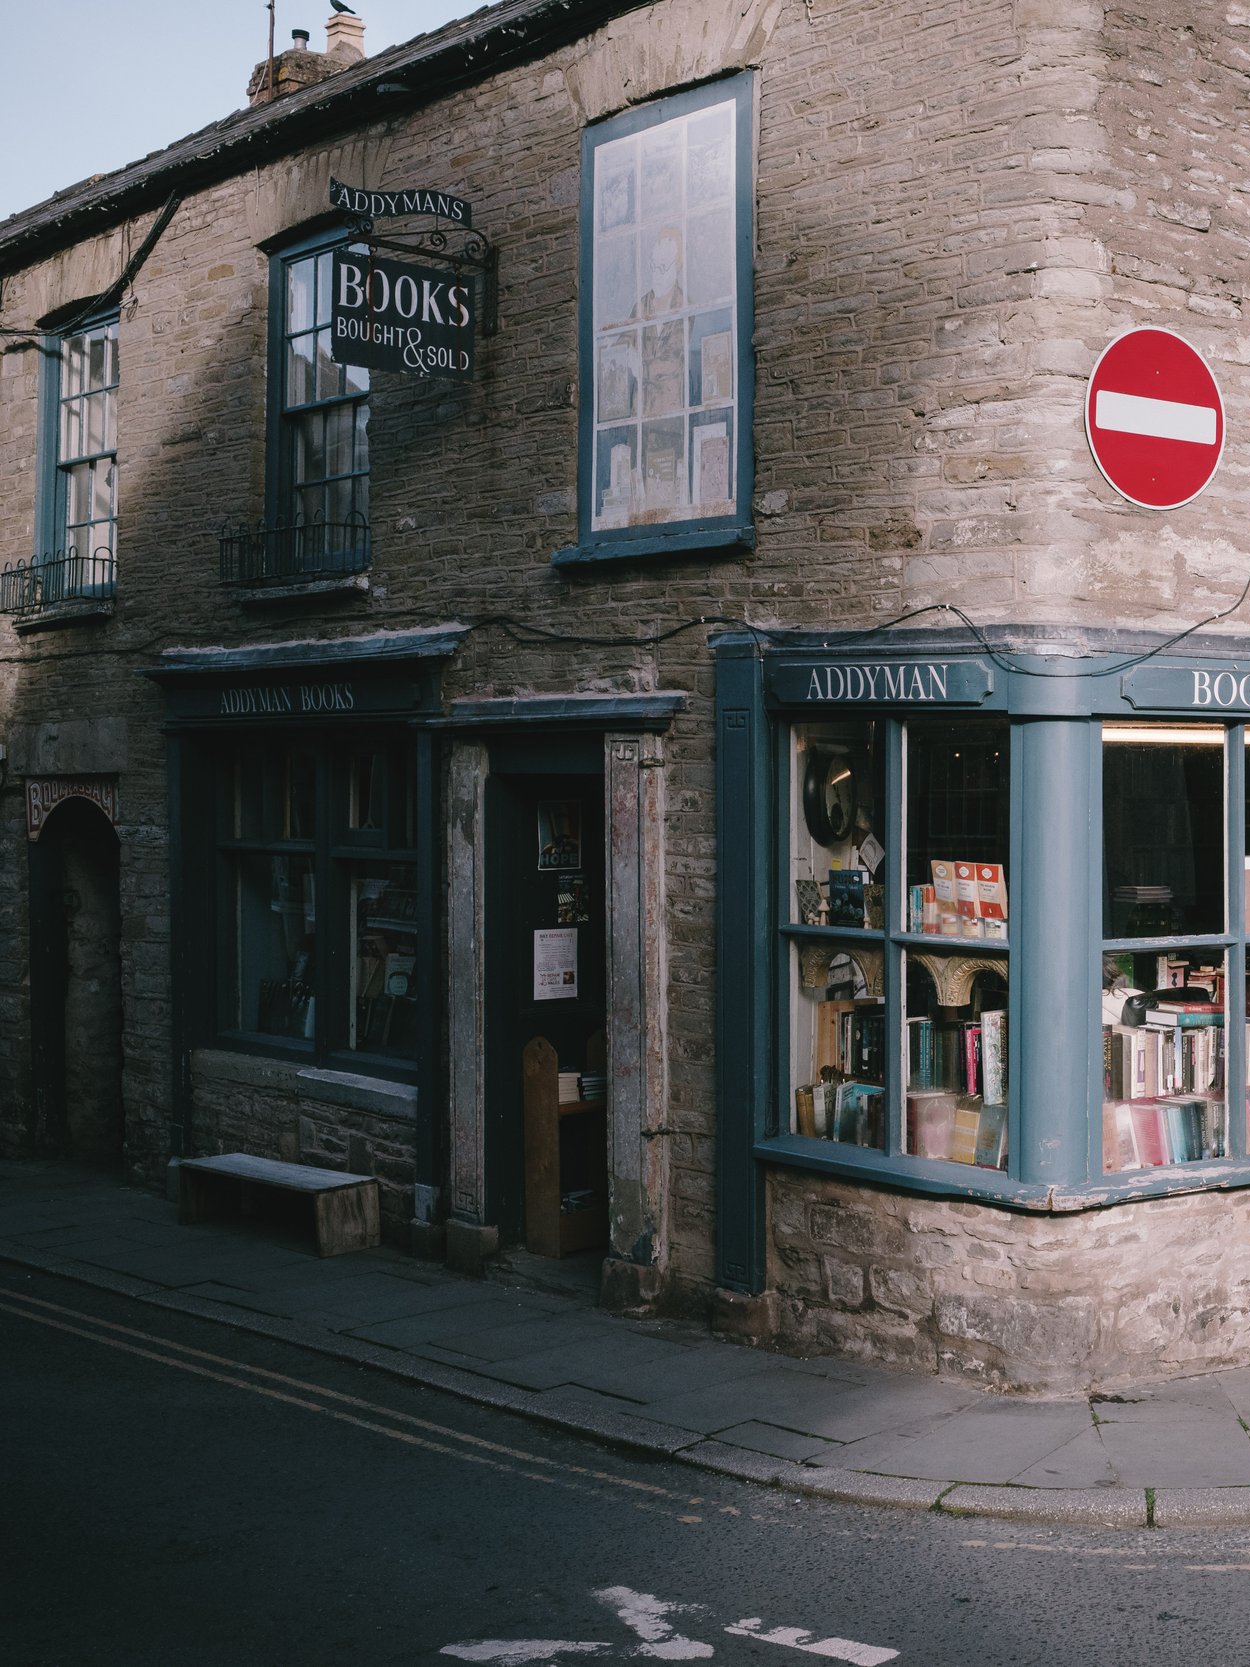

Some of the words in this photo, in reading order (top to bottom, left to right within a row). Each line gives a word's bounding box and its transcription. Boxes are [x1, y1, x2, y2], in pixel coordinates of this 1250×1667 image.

[337, 187, 464, 221] ADDYMANS
[338, 262, 470, 328] BOOKS
[336, 316, 405, 348] BOUGHT
[403, 327, 430, 373] &
[427, 345, 469, 371] SOLD
[219, 686, 292, 714] ADDYMAN
[299, 681, 355, 711] BOOKS
[806, 664, 949, 700] ADDYMAN
